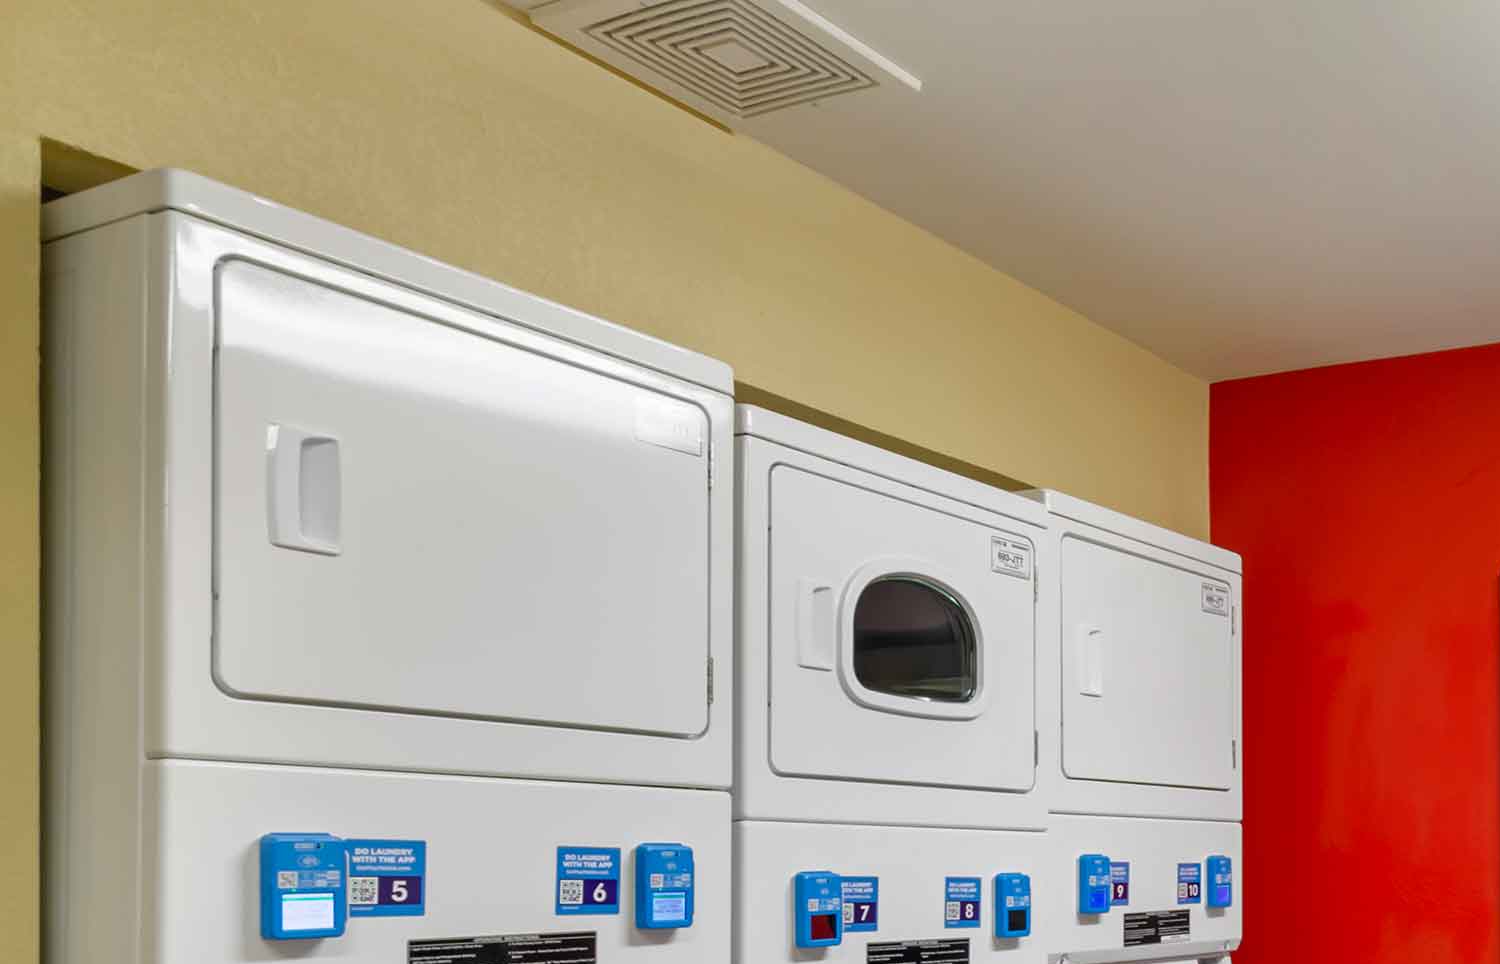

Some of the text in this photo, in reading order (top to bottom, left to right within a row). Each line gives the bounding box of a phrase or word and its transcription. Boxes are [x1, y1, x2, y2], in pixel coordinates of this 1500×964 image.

[391, 880, 408, 902] 5
[593, 882, 607, 902] 6
[1117, 884, 1124, 897] 9
[1189, 884, 1199, 897] 10
[860, 904, 870, 921] 7
[965, 903, 974, 919] 8
